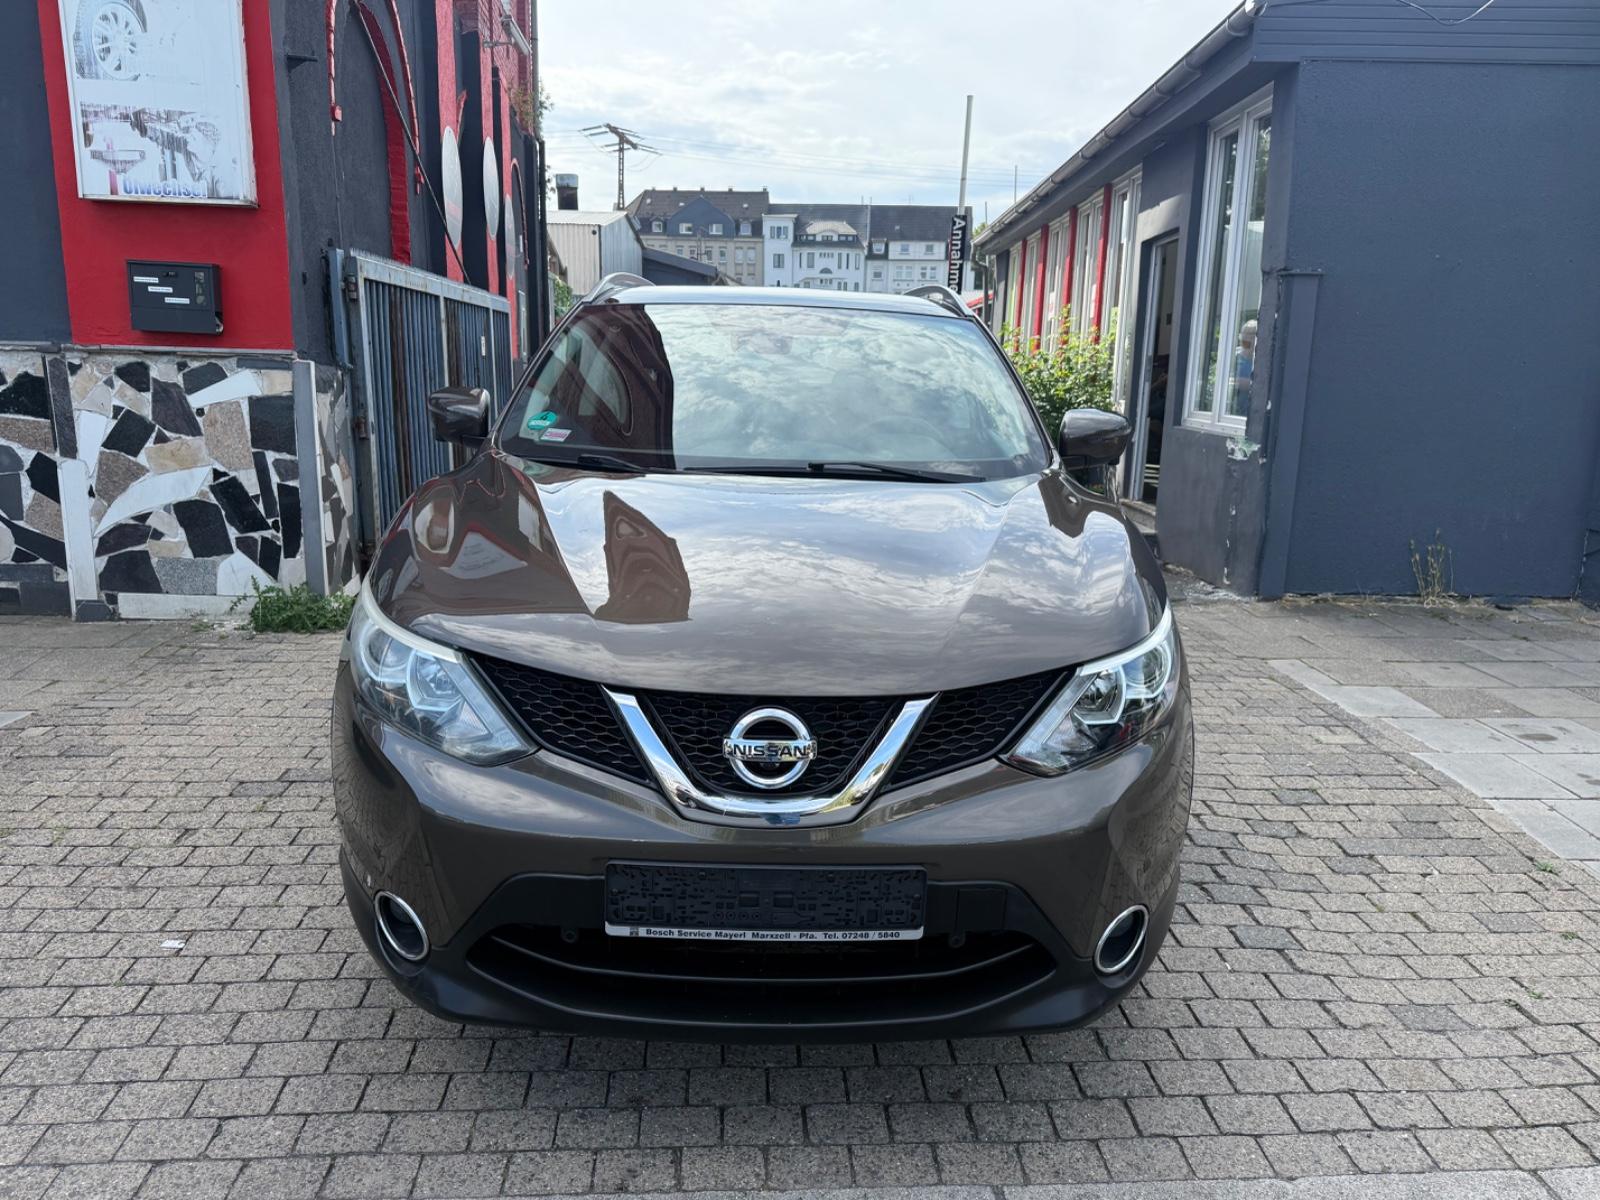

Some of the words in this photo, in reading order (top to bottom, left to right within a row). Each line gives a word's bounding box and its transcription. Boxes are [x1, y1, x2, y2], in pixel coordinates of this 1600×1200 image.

[733, 743, 807, 757] NISSAN
[645, 928, 674, 937] Bosch
[677, 930, 712, 938] Service
[878, 931, 900, 939] 5840
